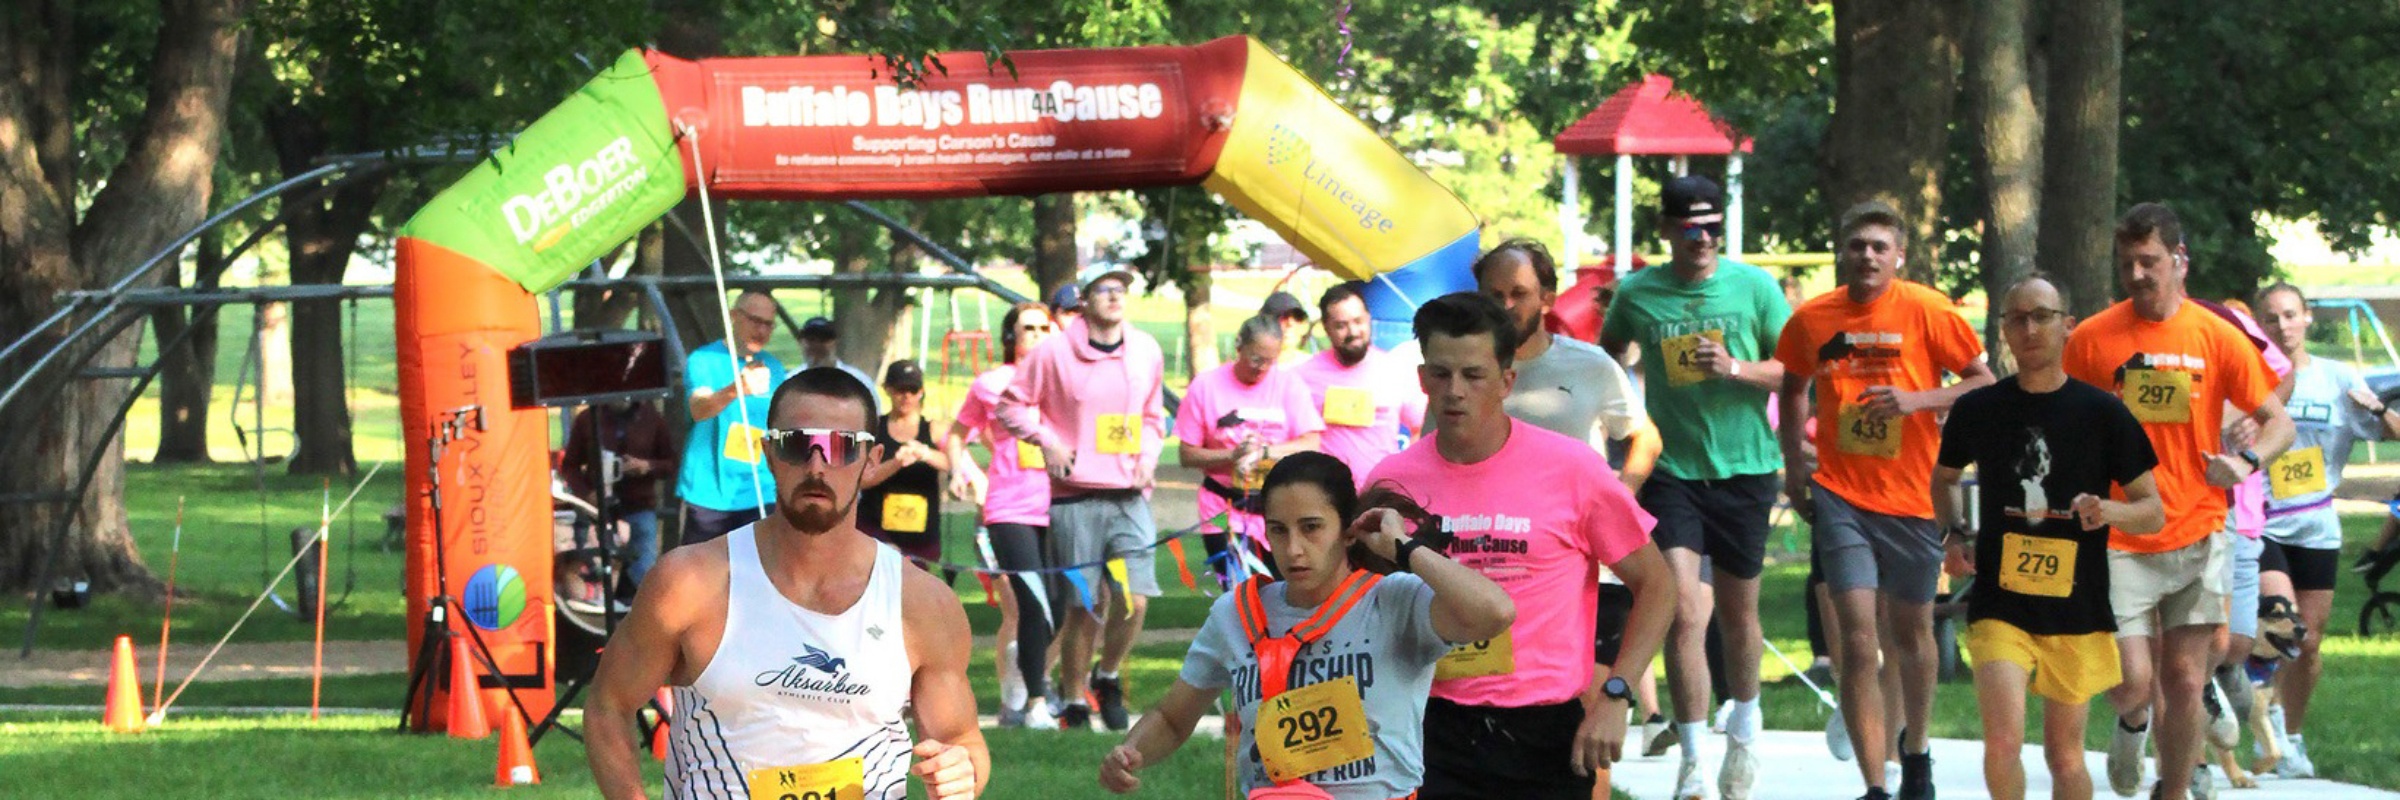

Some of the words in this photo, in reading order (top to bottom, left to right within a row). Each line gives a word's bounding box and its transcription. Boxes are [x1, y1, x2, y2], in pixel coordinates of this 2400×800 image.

[741, 84, 871, 127] Buffalo
[874, 84, 964, 130] Days
[966, 83, 1040, 124] Run
[1031, 92, 1058, 114] 4A
[1050, 79, 1164, 122] Cause
[852, 134, 937, 153] Supporting
[1007, 133, 1056, 148] Cause
[1303, 160, 1394, 235] Lineage
[1678, 350, 1699, 367] 43
[459, 342, 482, 454] VALEY
[2138, 384, 2176, 405] 297
[1851, 418, 1888, 441] 433
[2281, 460, 2314, 482] 282
[469, 463, 488, 556] SIOUX
[1441, 514, 1492, 533] Buffalo
[1494, 512, 1531, 533] Days
[1451, 535, 1479, 554] Run
[1482, 534, 1528, 554] Cause
[2017, 552, 2059, 576] 279
[754, 664, 871, 696] Aksarben
[777, 691, 822, 701] ATHLETIC
[827, 697, 851, 705] CLUB
[1277, 705, 1343, 749] 292
[1333, 755, 1377, 782] RUN
